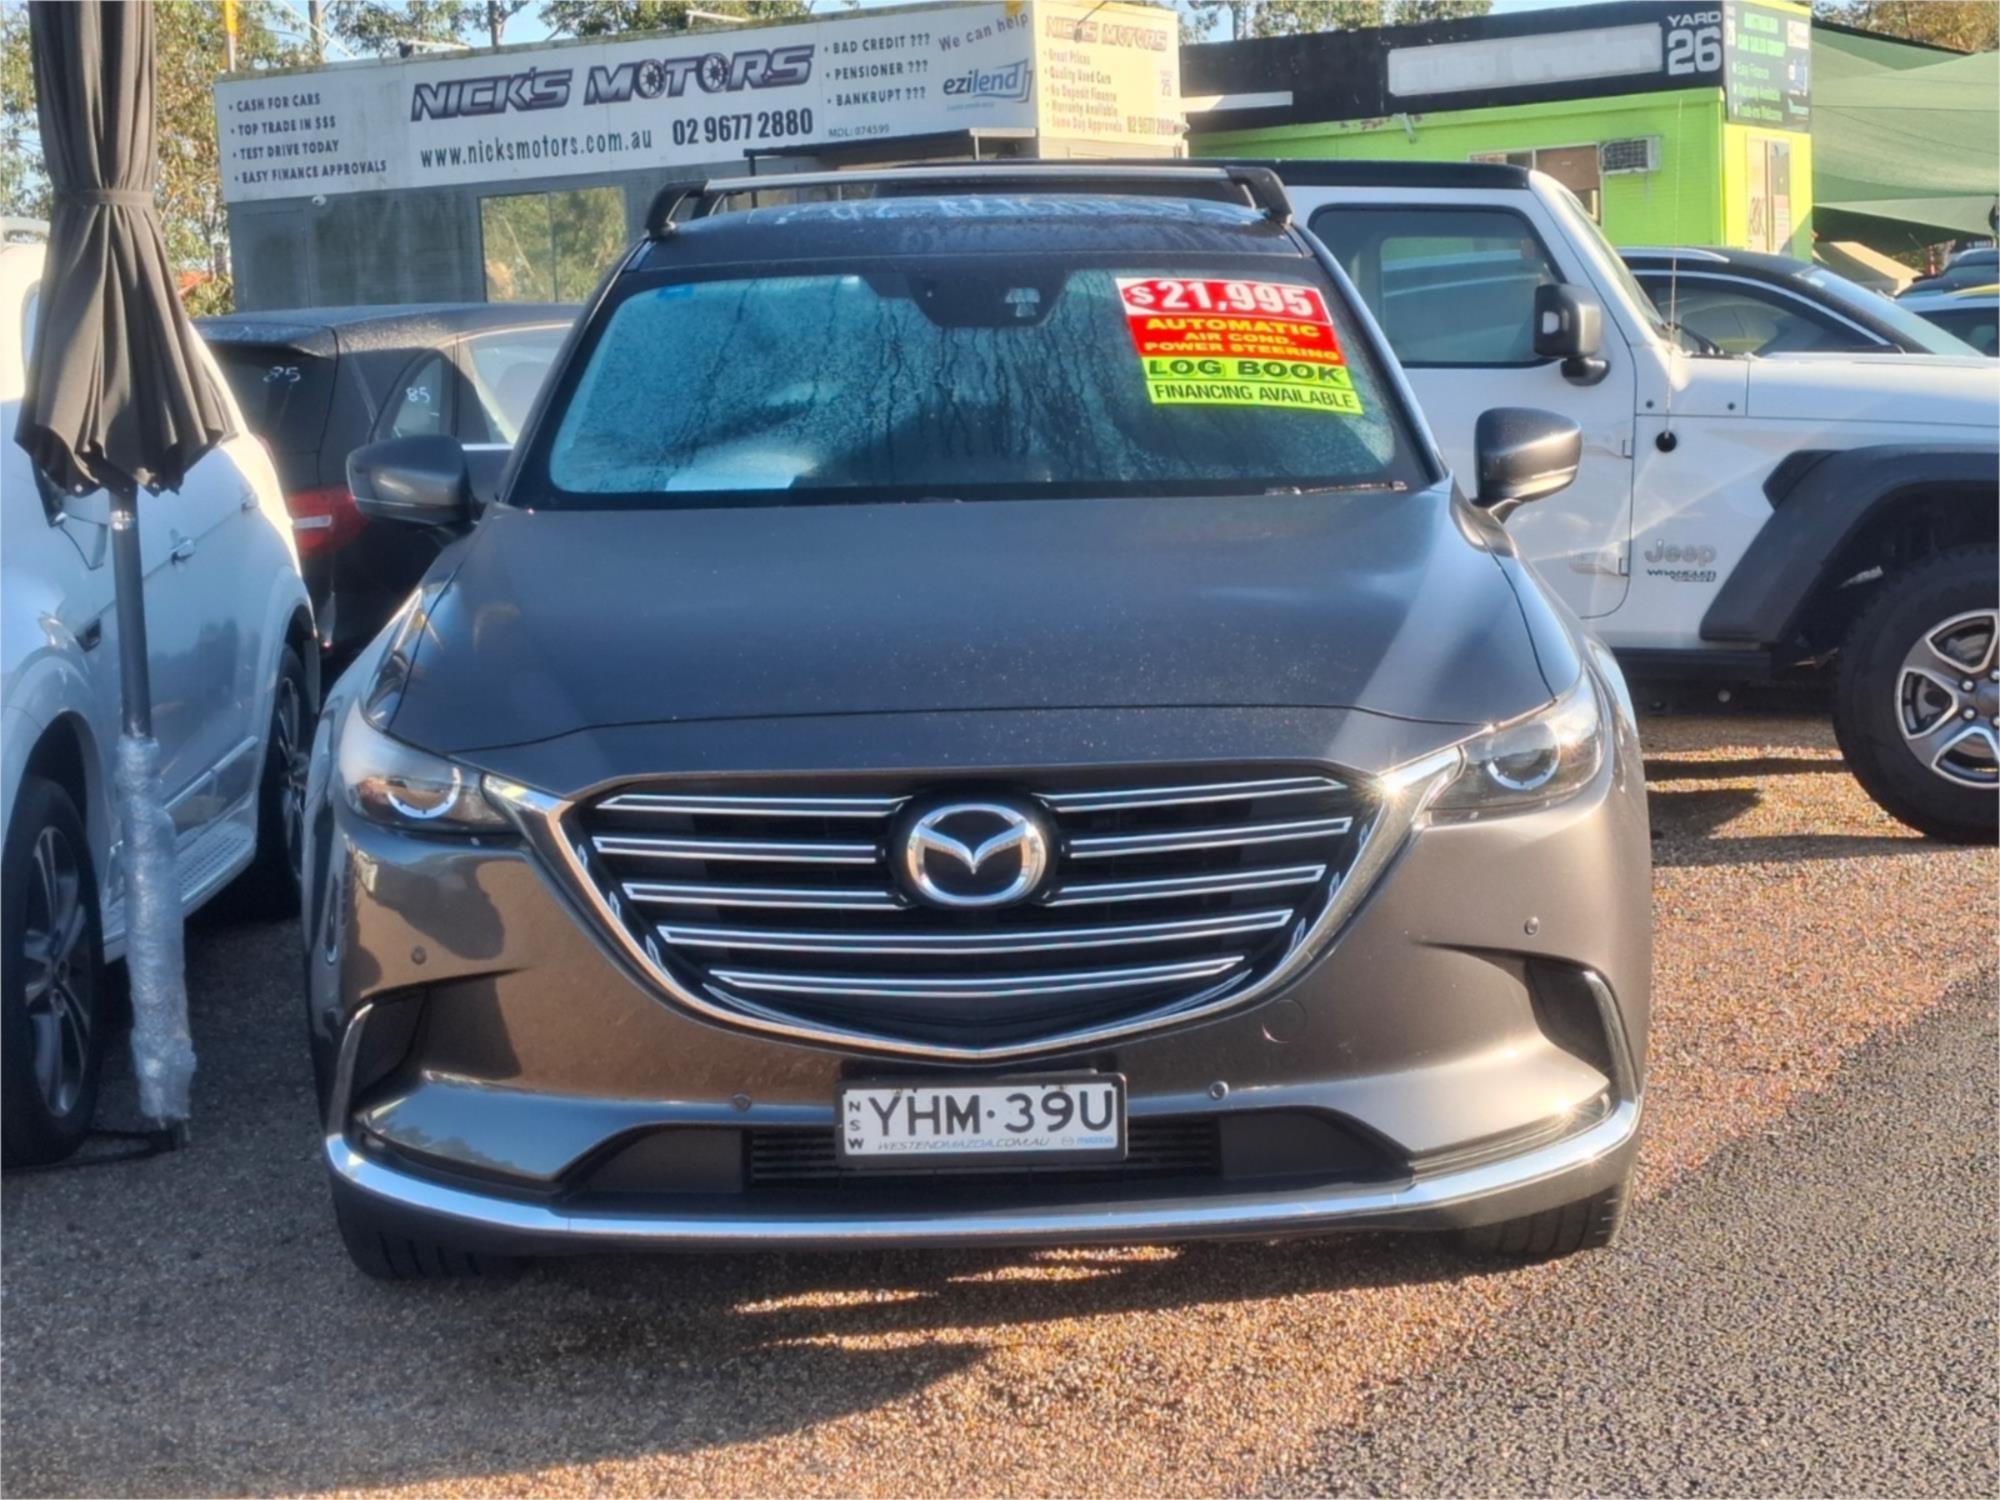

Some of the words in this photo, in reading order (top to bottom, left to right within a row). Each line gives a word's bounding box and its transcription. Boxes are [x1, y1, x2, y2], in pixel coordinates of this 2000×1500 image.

[1667, 10, 1721, 27] YARD
[938, 35, 961, 52] We
[966, 25, 992, 43] can
[996, 13, 1029, 33] help
[833, 40, 858, 55] BAD
[862, 36, 906, 51] CREDIT
[910, 33, 931, 47] ???
[1667, 26, 1722, 76] 26
[834, 62, 904, 80] PENSIONER
[908, 60, 929, 74] ???
[943, 64, 1020, 95] ezilend
[1096, 71, 1112, 85] Cars
[411, 67, 573, 122] NICK'S
[583, 44, 815, 105] MOTORS
[236, 99, 265, 112] CASH
[268, 96, 289, 110] FOR
[293, 93, 321, 107] CARS
[836, 89, 901, 107] BANKRUPT
[906, 86, 926, 101] ???
[238, 122, 258, 136] TOP
[261, 119, 296, 134] TRADE
[301, 117, 312, 131] IN
[672, 118, 699, 146] 02
[704, 112, 752, 143] 9677
[757, 107, 813, 139] 2880
[239, 147, 264, 160] TEST
[268, 143, 299, 158] DRIVE
[302, 139, 340, 154] TODAY
[420, 128, 653, 168] www.nicksmotors.com.au
[242, 170, 268, 184] EASY
[272, 165, 318, 181] FINANCE
[321, 160, 387, 177] APPROVALS
[1129, 281, 1313, 316] $21,995
[1146, 318, 1320, 338] AUTOMATIC
[1184, 332, 1221, 342] AIR
[1228, 333, 1297, 346] COND.
[1145, 342, 1225, 352] POWER
[1231, 344, 1339, 361] STEERING
[1150, 359, 1222, 375] LOG
[1238, 361, 1346, 383] BOOK
[405, 386, 431, 403] 85
[1154, 384, 1253, 400] FINANCING
[1259, 386, 1356, 408] AVAILABLE
[1644, 538, 1717, 567] Jeep
